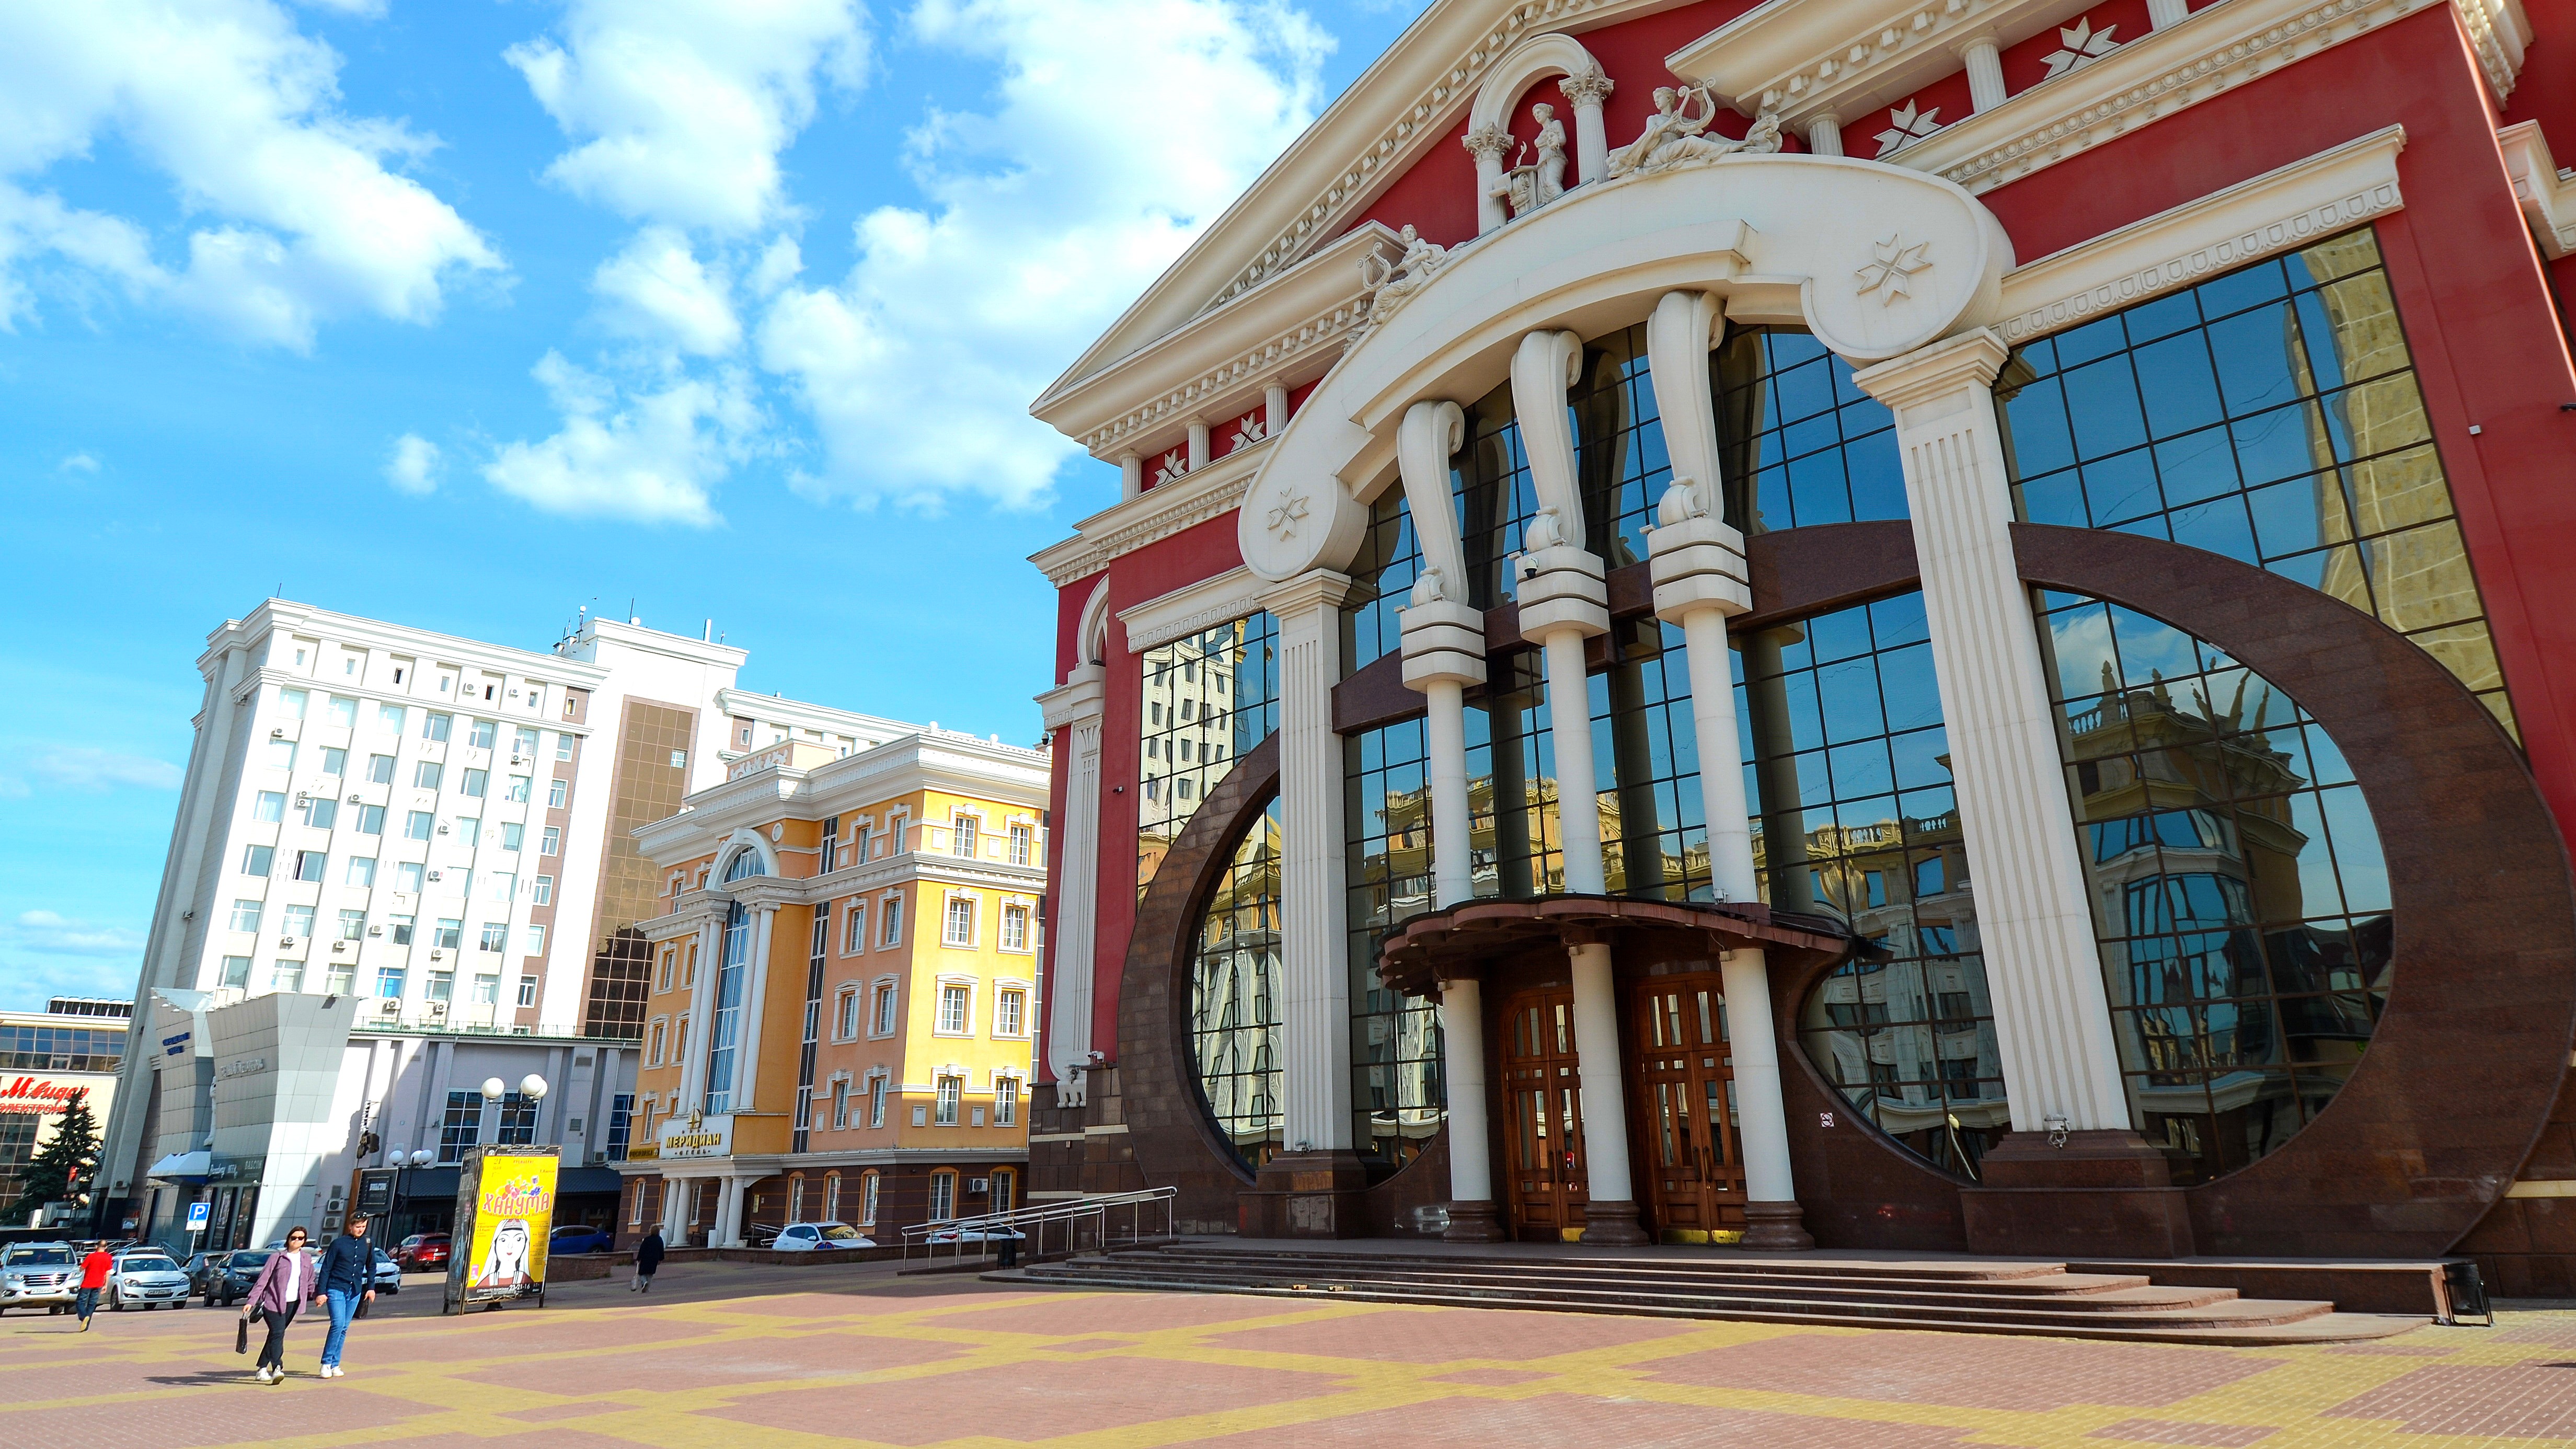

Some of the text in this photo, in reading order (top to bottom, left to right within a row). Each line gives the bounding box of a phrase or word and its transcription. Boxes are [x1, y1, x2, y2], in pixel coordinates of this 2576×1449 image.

[665, 1133, 721, 1148] МЕРИДИАН
[483, 1192, 550, 1215] ХАНУМА
[193, 1205, 206, 1220] P
